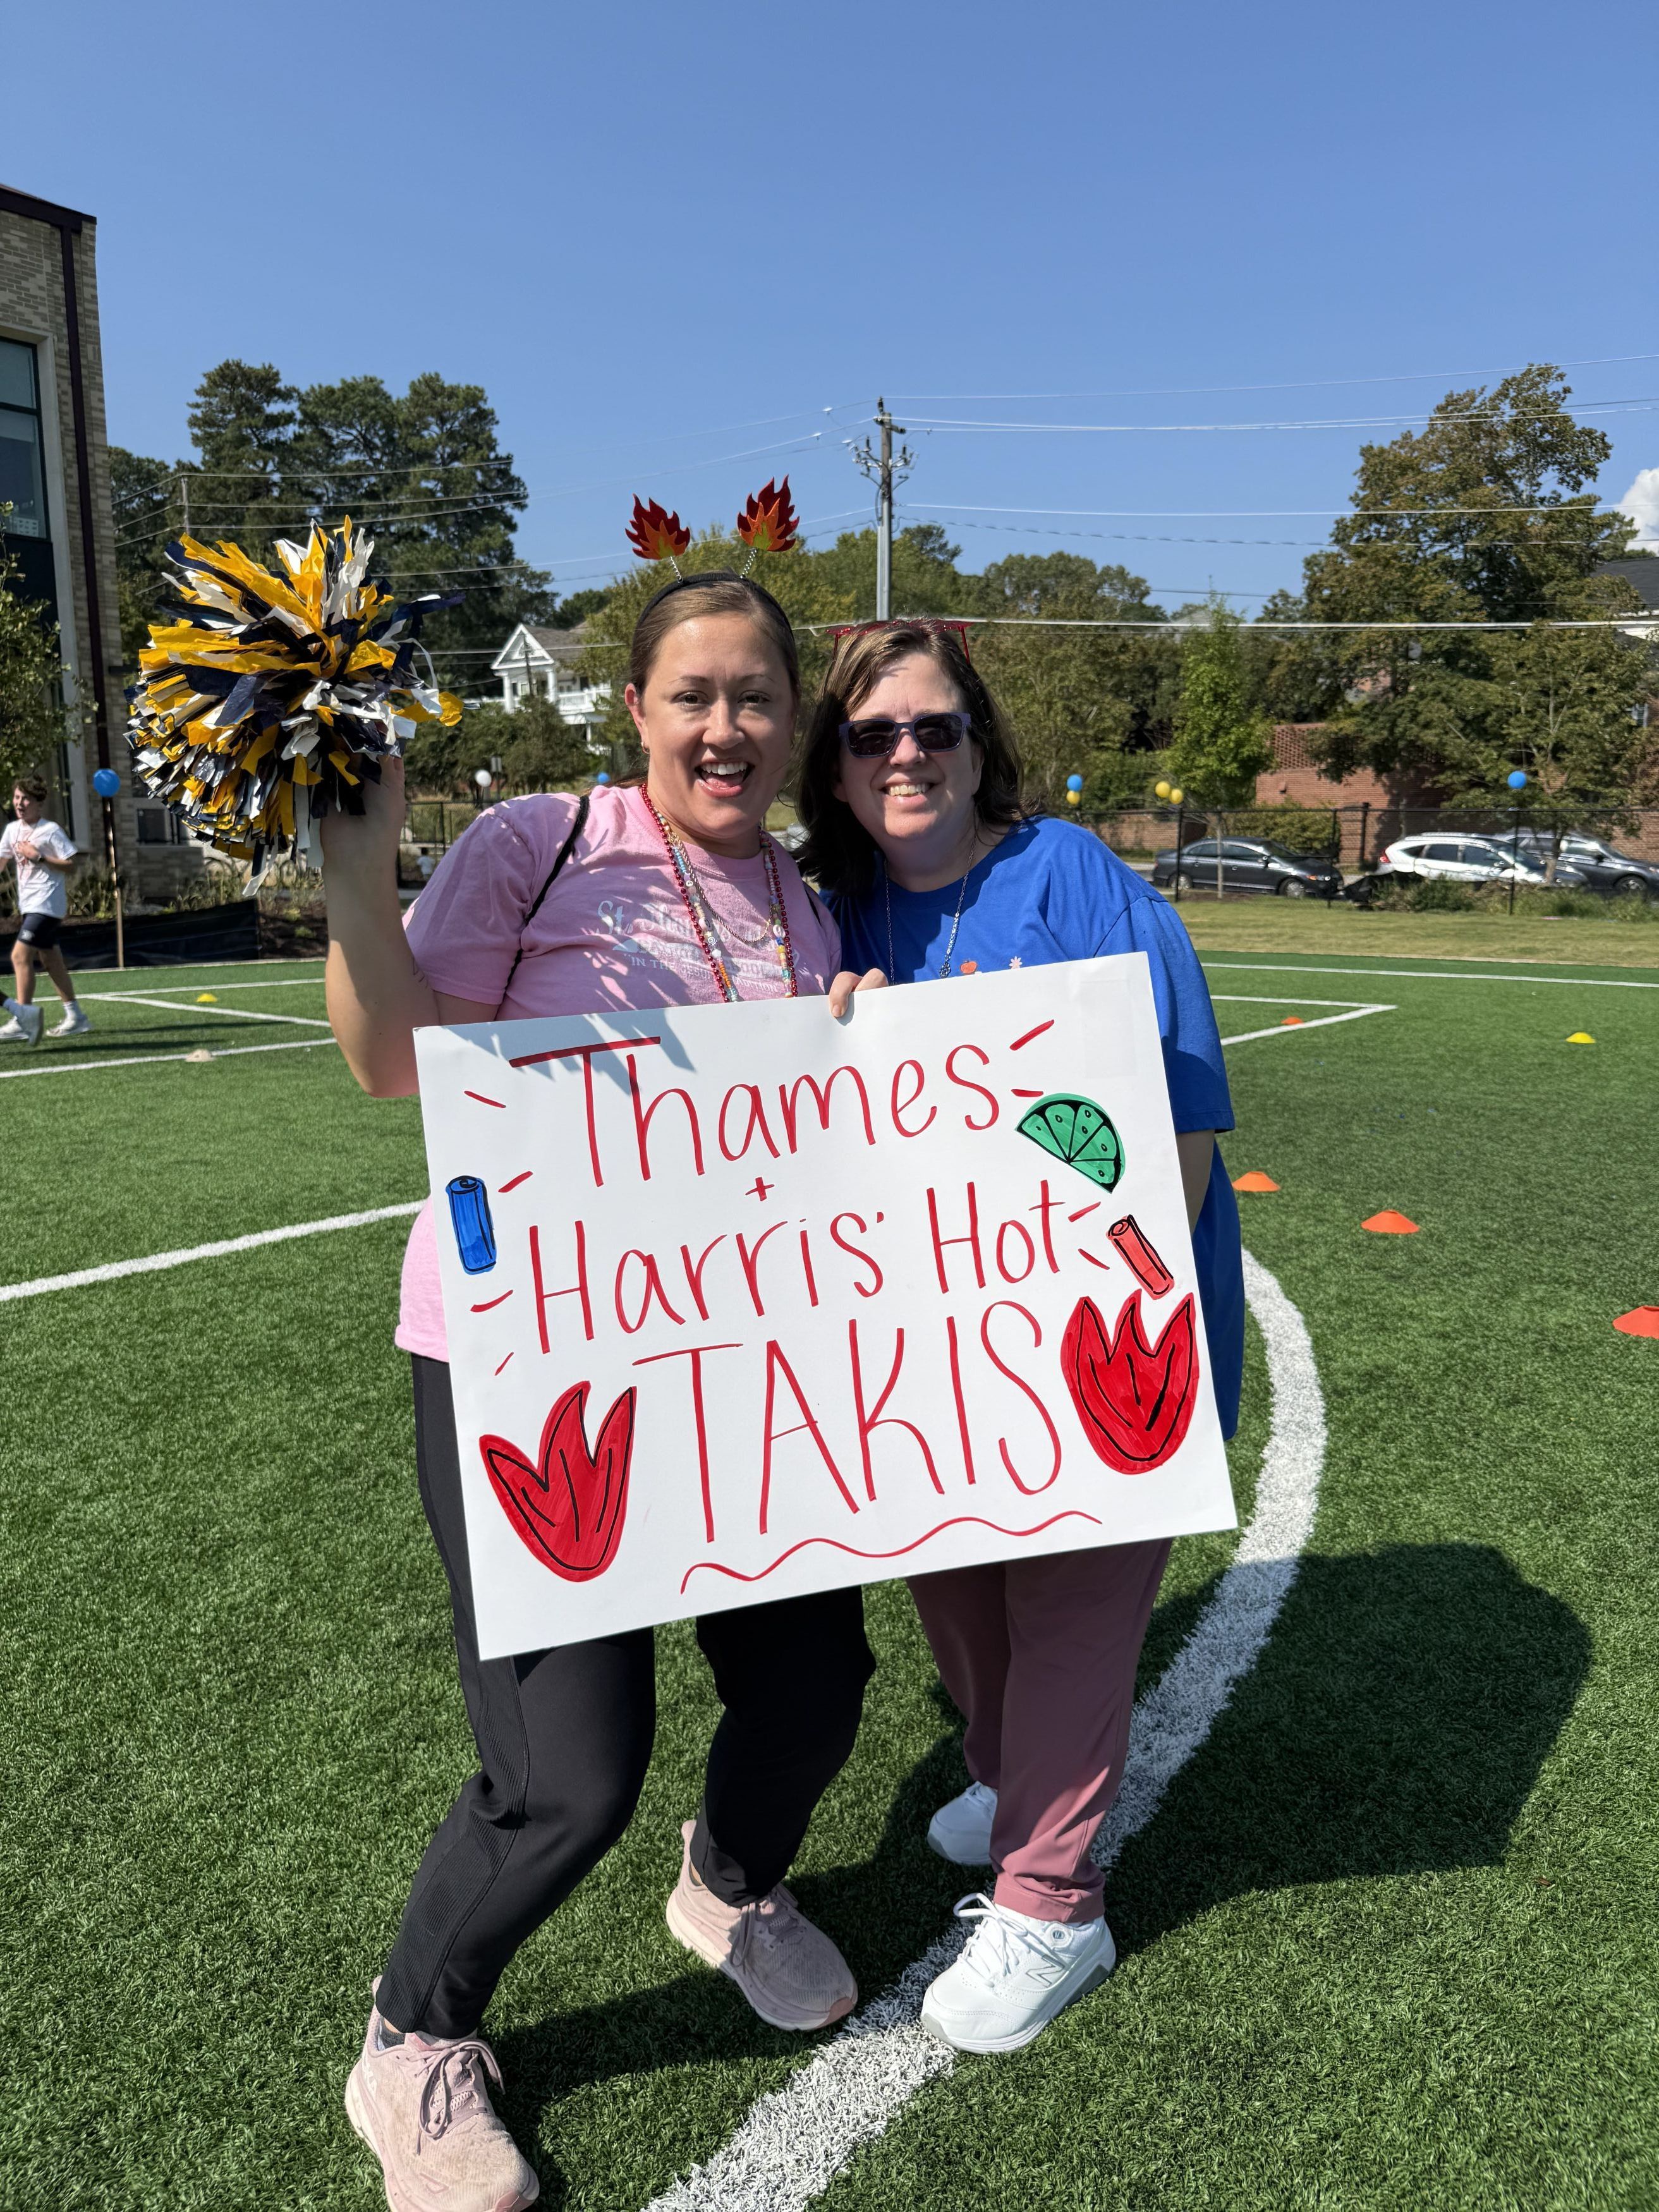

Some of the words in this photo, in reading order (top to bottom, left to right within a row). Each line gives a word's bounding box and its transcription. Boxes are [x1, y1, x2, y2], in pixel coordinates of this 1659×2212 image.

[510, 1037, 1000, 1187] Thames
[926, 1180, 1063, 1294] Hot
[633, 1300, 1062, 1543] TAKIS
